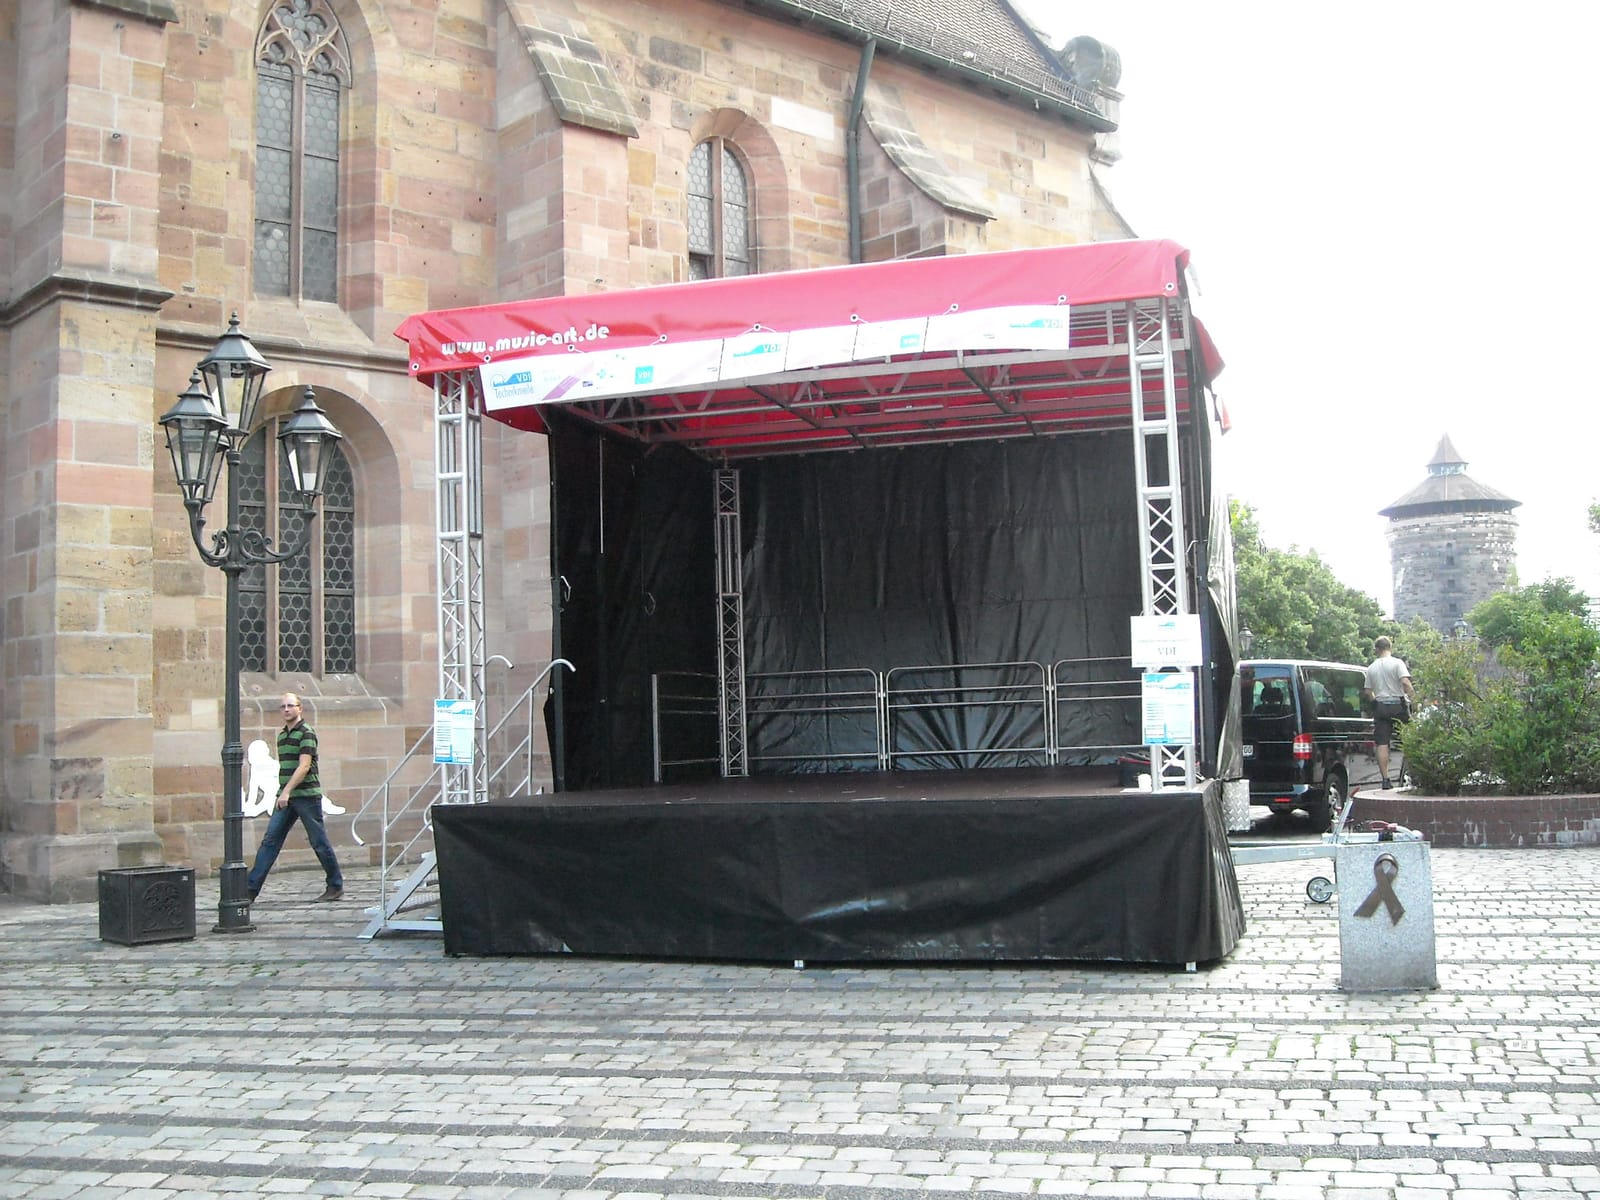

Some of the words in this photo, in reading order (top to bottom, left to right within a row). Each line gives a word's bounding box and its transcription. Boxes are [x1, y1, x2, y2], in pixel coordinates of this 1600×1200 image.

[441, 323, 610, 355] www.music-art.de
[516, 372, 532, 382] VDI
[1157, 646, 1177, 656] VDI
